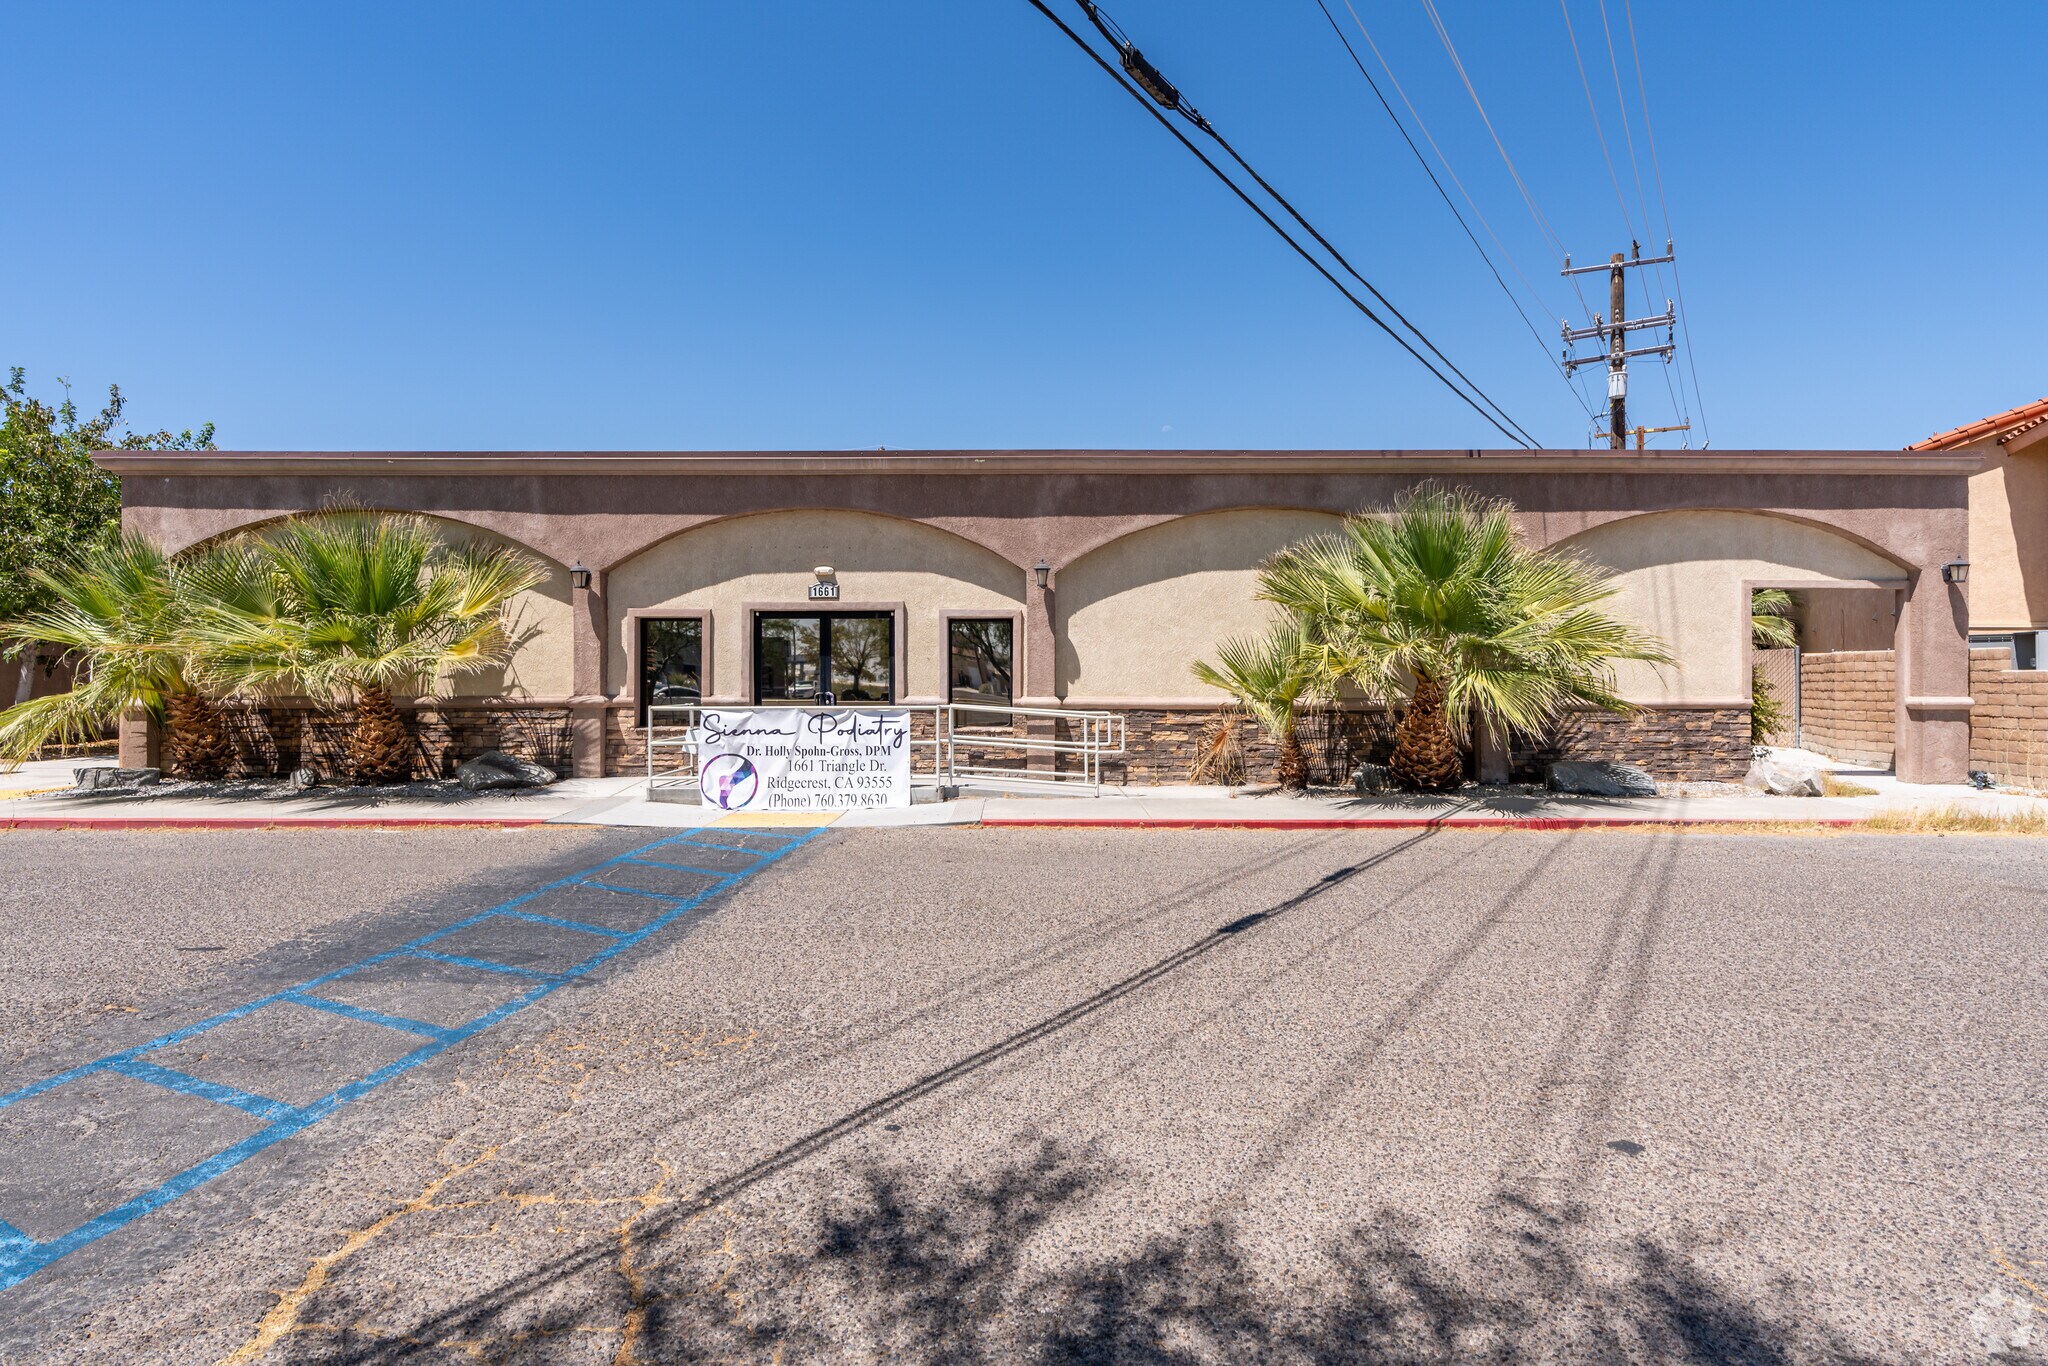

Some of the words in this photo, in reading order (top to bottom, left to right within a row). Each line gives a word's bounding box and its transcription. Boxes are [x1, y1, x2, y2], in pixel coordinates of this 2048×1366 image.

[813, 586, 835, 597] 1661
[703, 713, 796, 745] Sienna
[808, 712, 908, 749] Podiatry
[747, 746, 761, 756] Dr.
[765, 745, 791, 758] Holly
[865, 746, 891, 756] DPM
[788, 760, 814, 772] 1661
[818, 760, 866, 774] Triangle
[870, 760, 887, 772] Dr.
[767, 776, 831, 791] Ridgecrest,
[834, 777, 854, 789] CA
[857, 777, 892, 789] 93555
[768, 794, 811, 808] (Phone)
